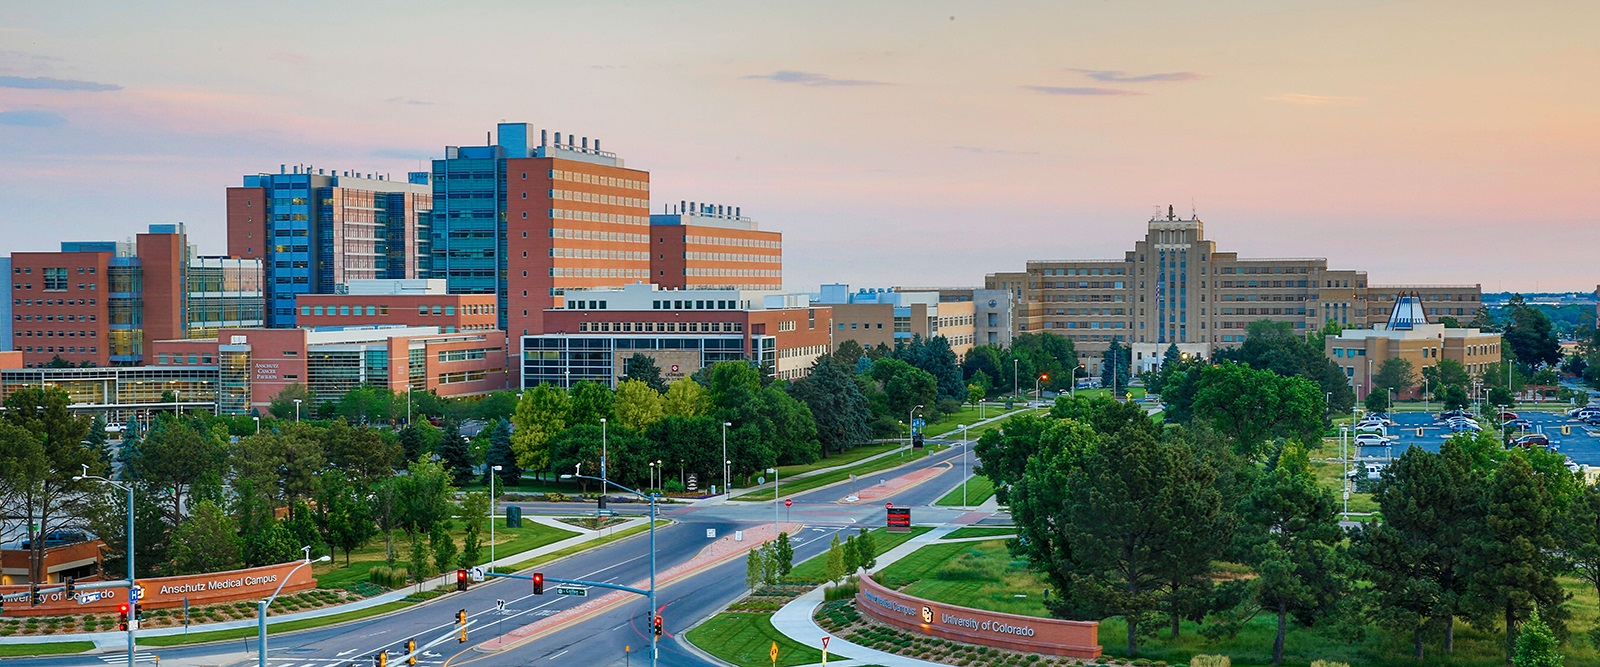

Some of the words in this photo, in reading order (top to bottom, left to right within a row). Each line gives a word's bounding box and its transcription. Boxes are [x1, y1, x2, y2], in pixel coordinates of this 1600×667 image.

[160, 583, 206, 595] Anschutz
[208, 577, 243, 590] Medical
[244, 574, 277, 586] Campus
[51, 592, 63, 602] of
[892, 600, 917, 616] Campus
[941, 613, 980, 631] University
[981, 620, 992, 631] of
[992, 621, 1035, 637] Colorado
